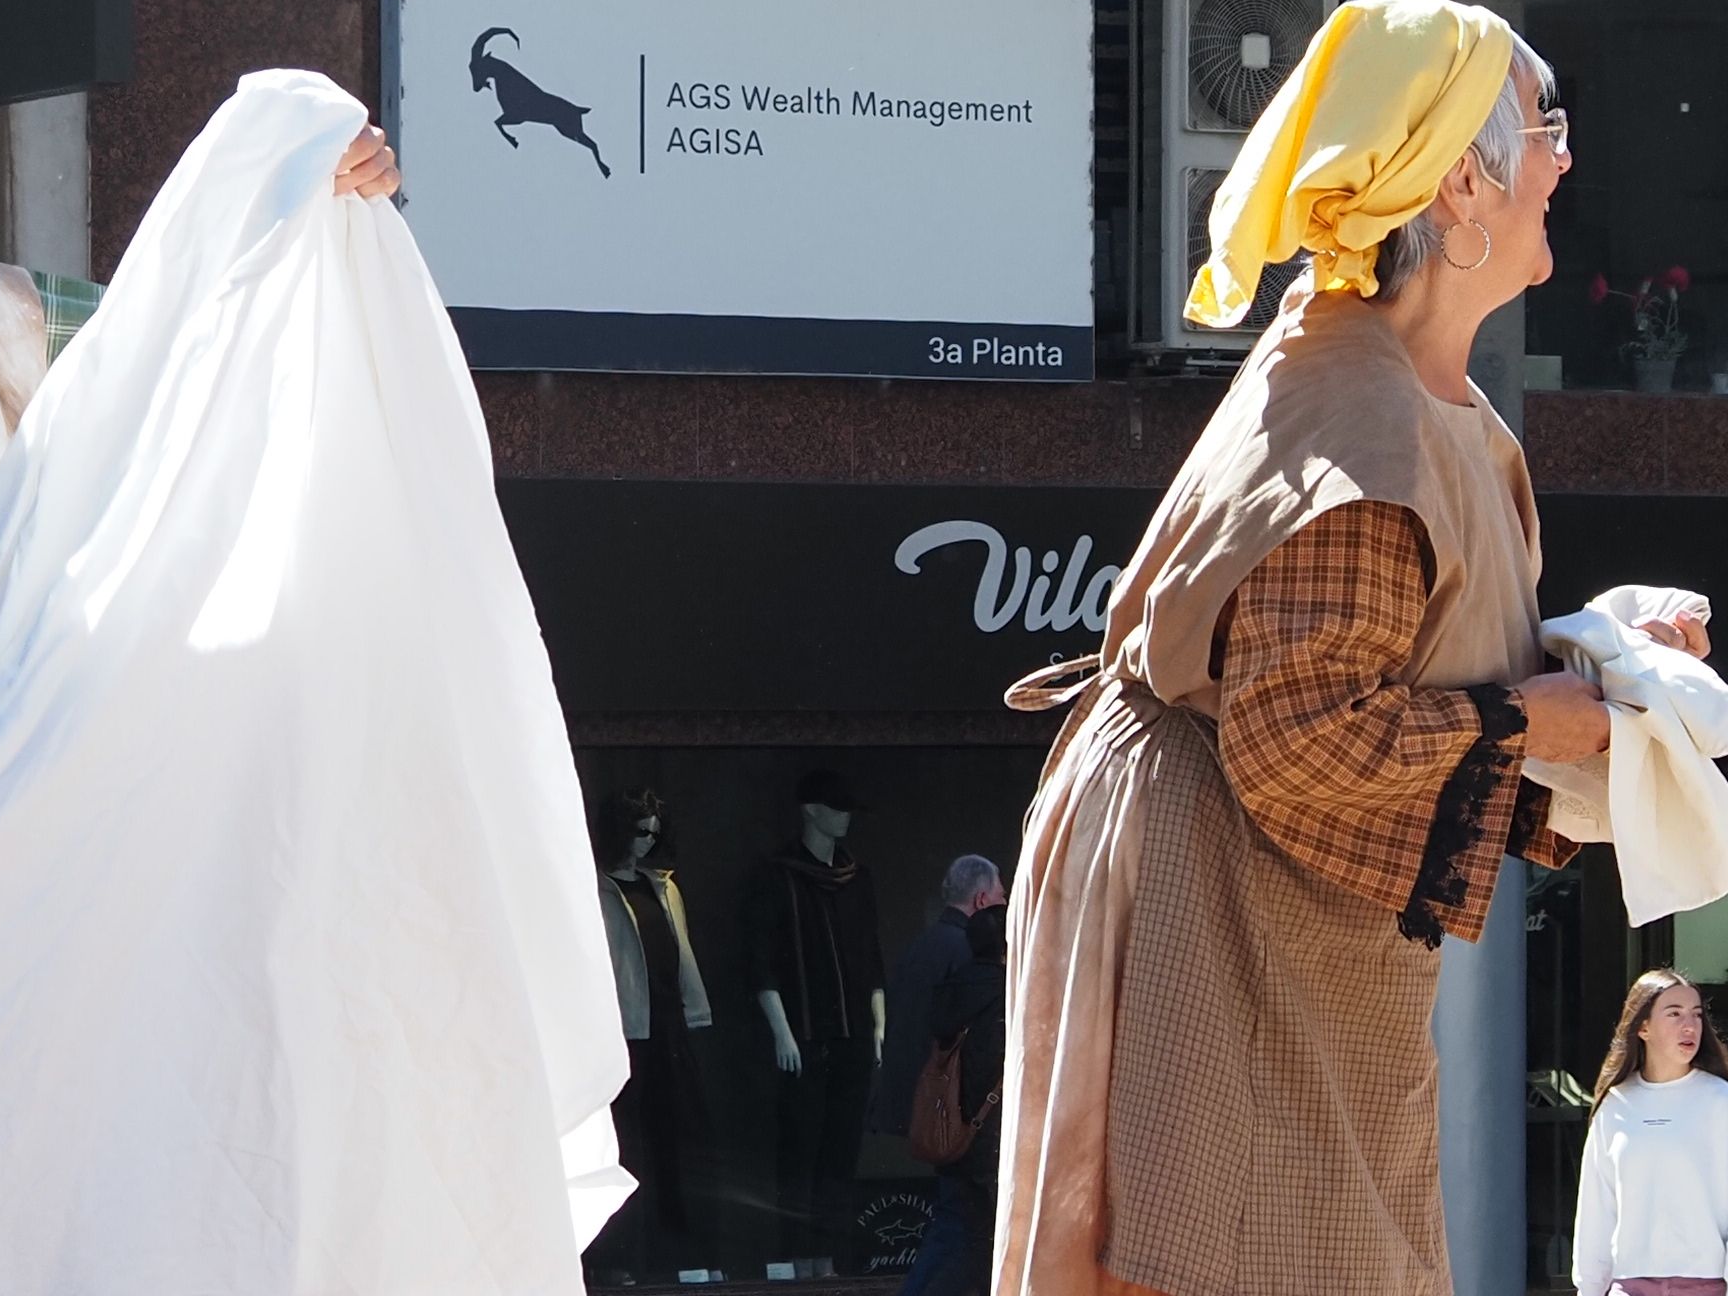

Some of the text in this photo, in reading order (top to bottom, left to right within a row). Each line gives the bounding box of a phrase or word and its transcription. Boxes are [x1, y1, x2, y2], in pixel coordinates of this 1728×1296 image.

[666, 82, 1034, 127] AGS Wealth Management
[666, 126, 764, 157] AGISA
[928, 336, 1063, 367] 3a Planta
